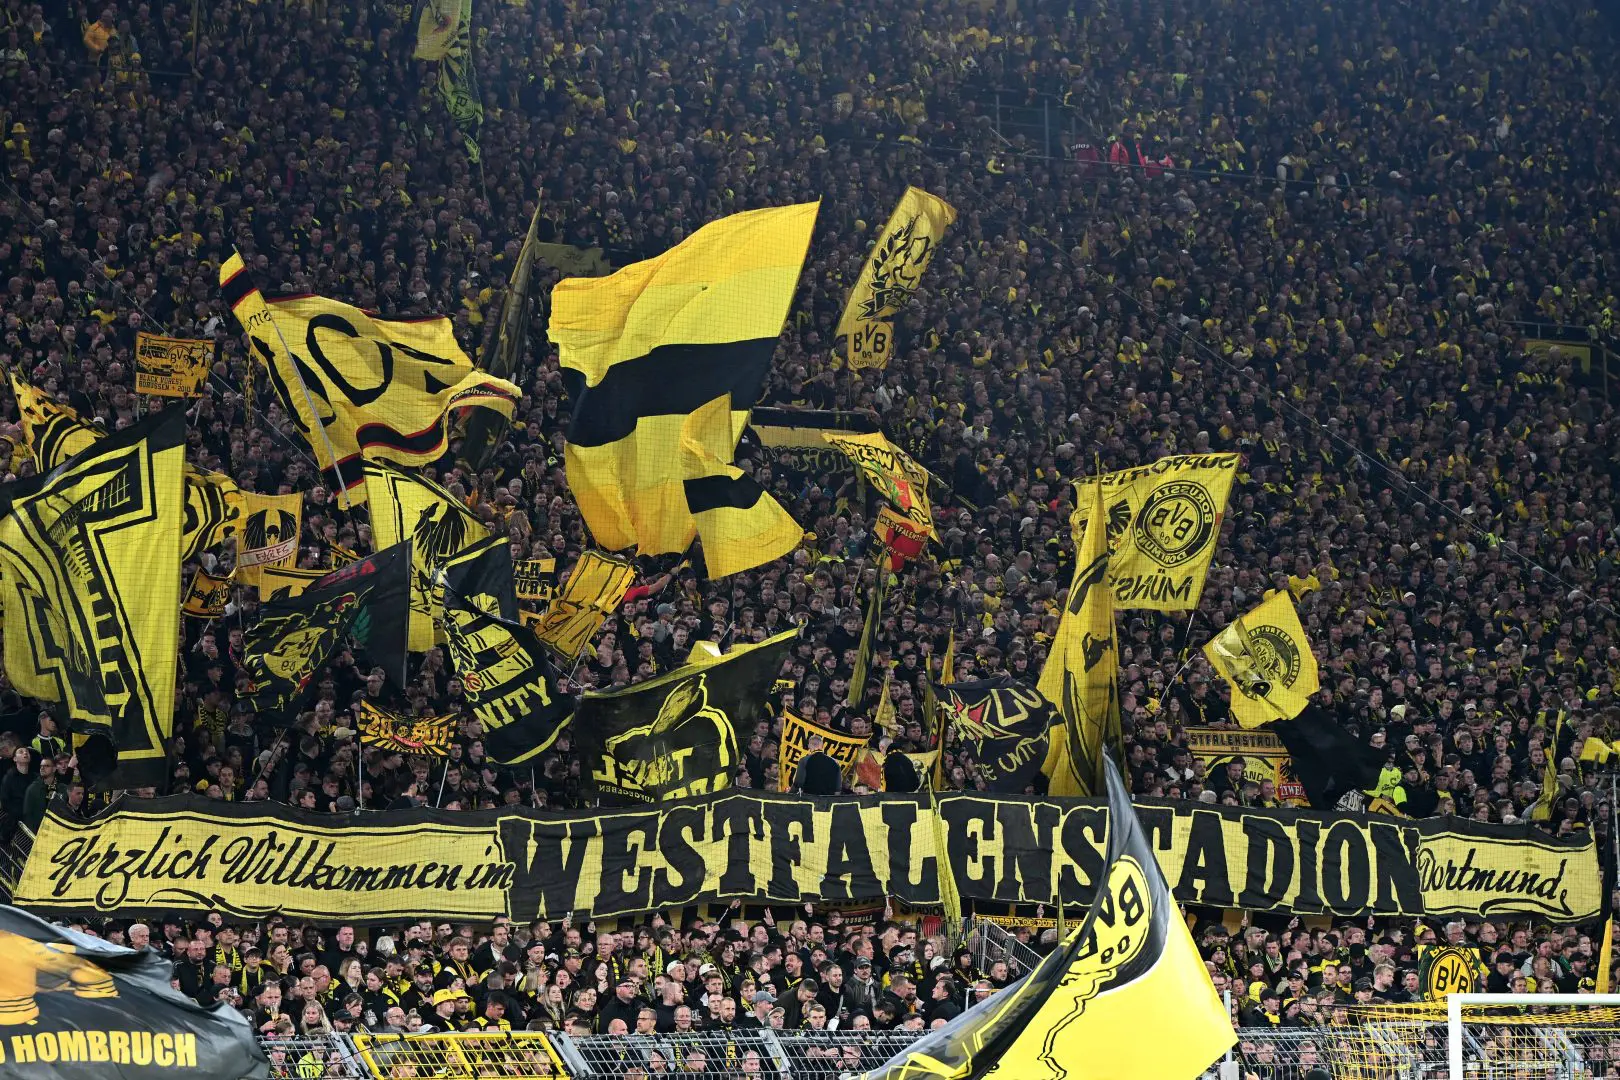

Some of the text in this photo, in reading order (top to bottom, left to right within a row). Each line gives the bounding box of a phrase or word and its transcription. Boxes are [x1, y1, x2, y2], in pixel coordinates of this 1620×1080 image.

[854, 324, 886, 353] BVB
[139, 373, 159, 382] BLACK
[177, 385, 191, 393] 2010
[473, 675, 552, 733] NITY
[50, 826, 212, 910] Herzlich
[219, 830, 461, 892] Willkommen
[464, 844, 516, 890] im
[1418, 848, 1568, 901] Dortmund
[11, 1030, 197, 1068] HOMBRUCH
